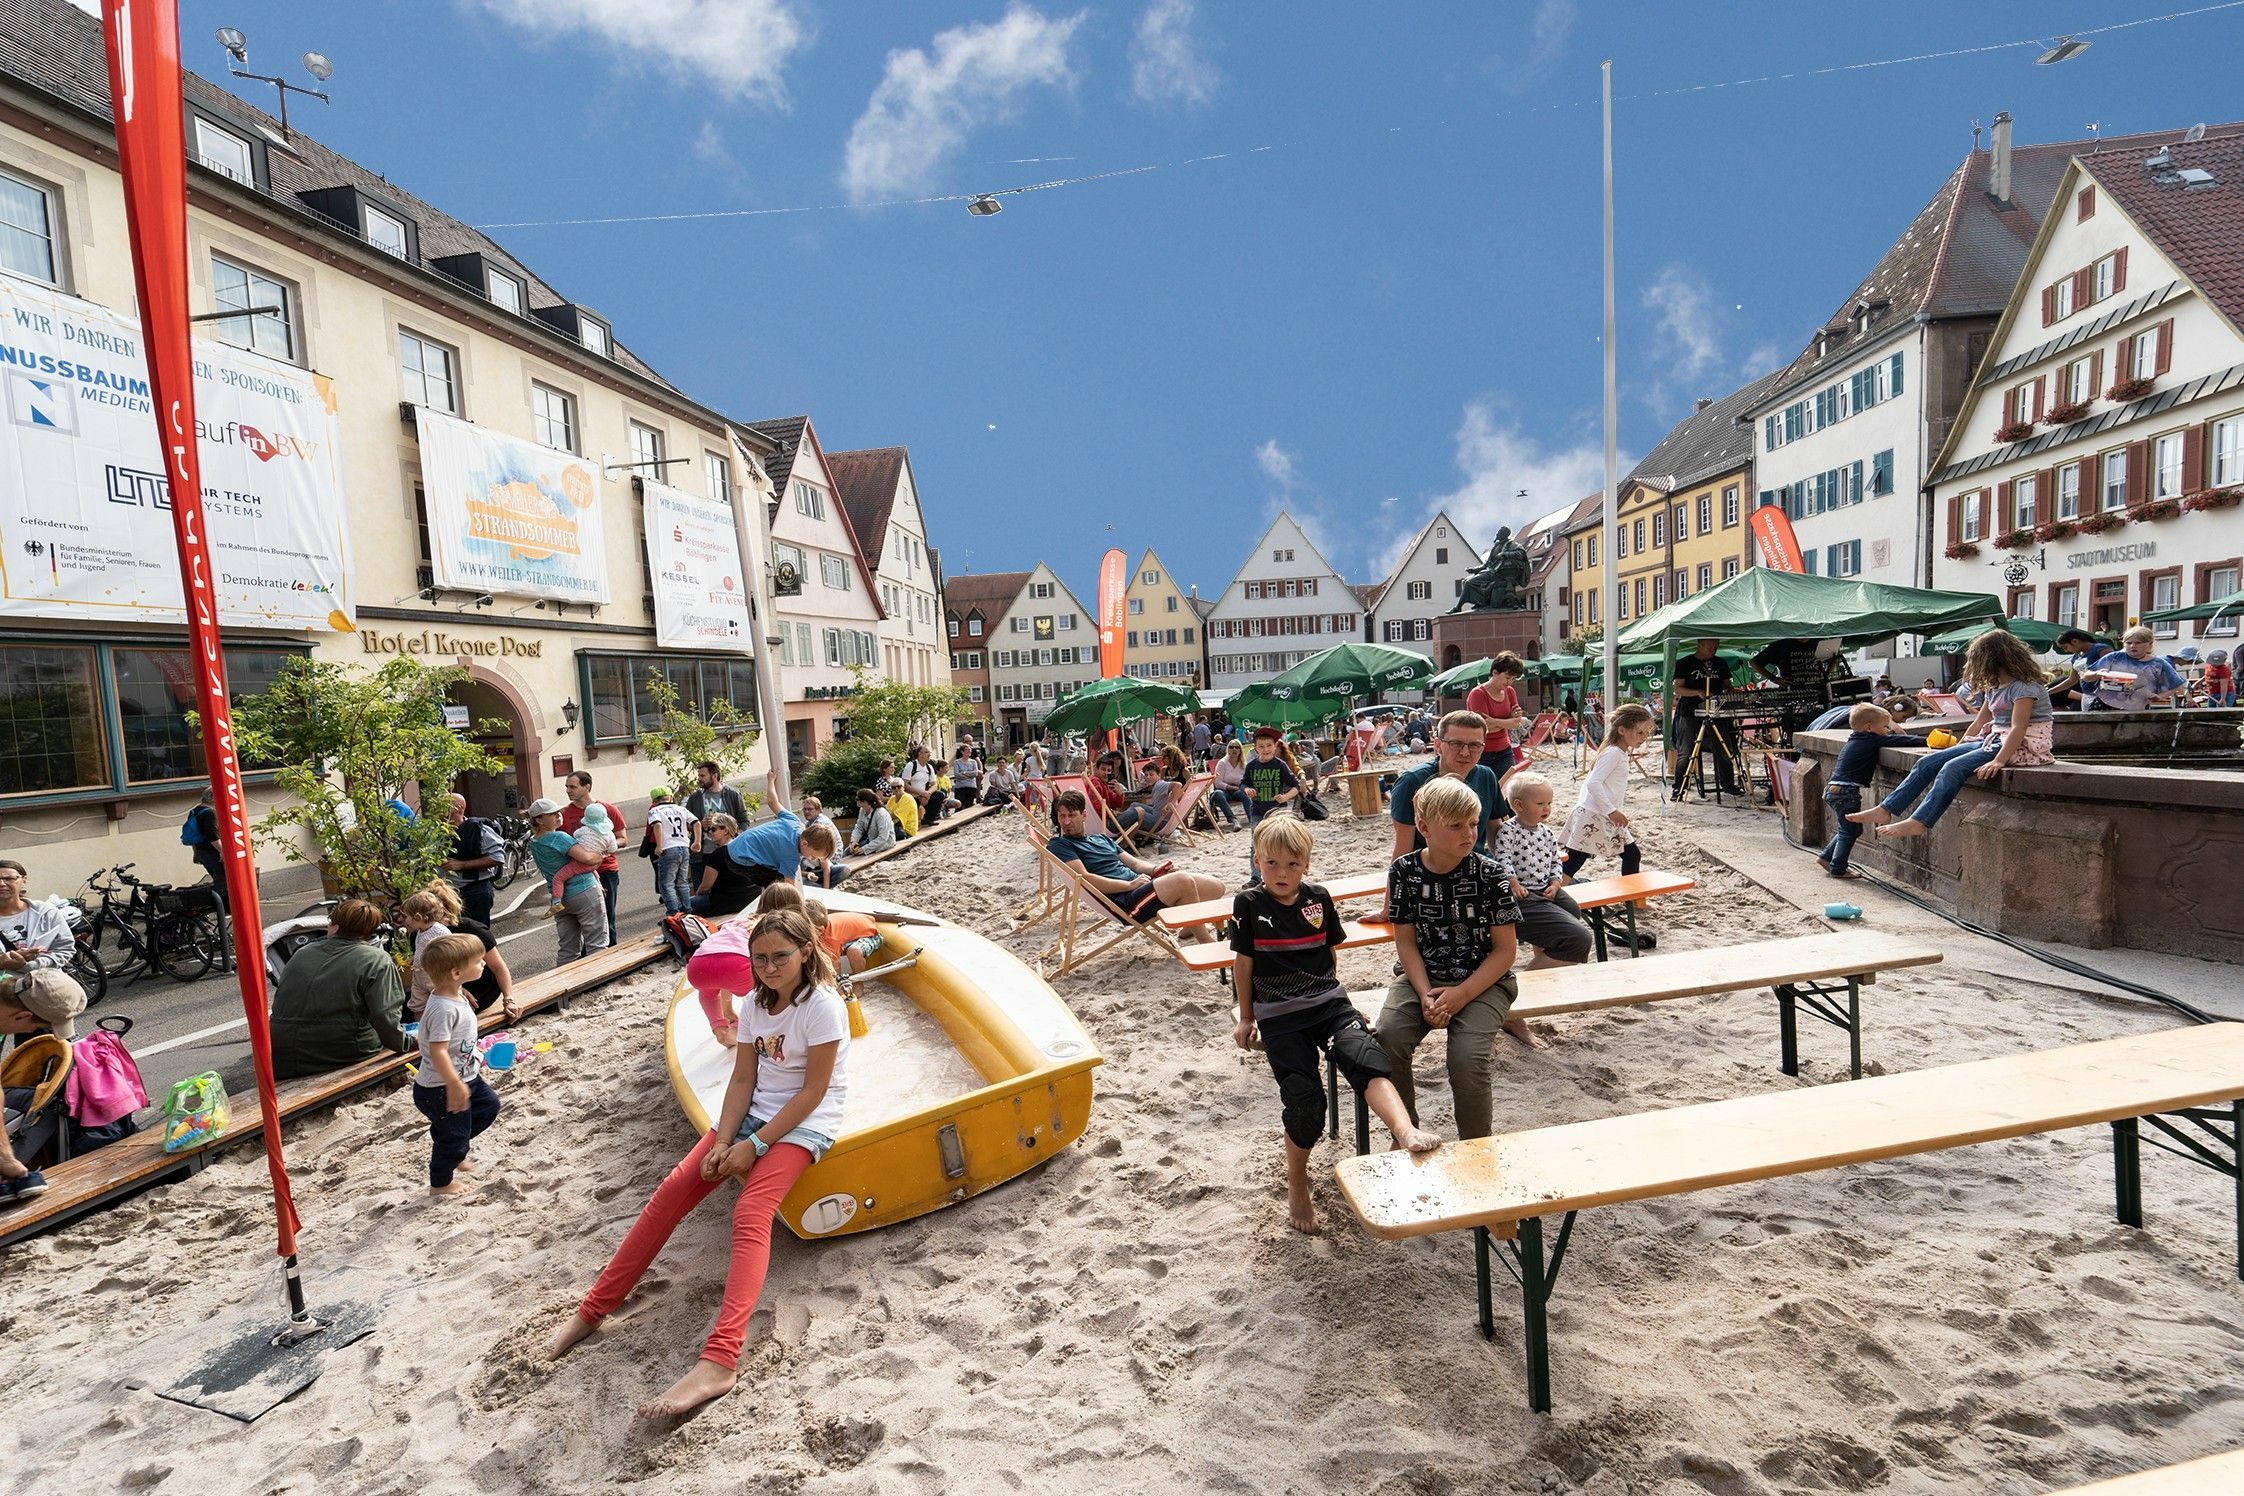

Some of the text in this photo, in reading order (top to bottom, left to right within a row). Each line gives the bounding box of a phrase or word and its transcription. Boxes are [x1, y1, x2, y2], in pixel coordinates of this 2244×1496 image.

[12, 307, 53, 336] WIR
[62, 321, 136, 358] DANKEN
[0, 343, 150, 398] NUSSBAUM
[81, 386, 151, 413] MEDIEN
[224, 490, 261, 505] TECH
[203, 501, 263, 519] YSTEMS
[68, 523, 90, 532] vom
[472, 511, 577, 549] STRANDSOMMER
[59, 543, 133, 558] Bundesministerium
[216, 541, 329, 561] im Rahmen des Bundesprogmms
[2066, 541, 2157, 569] STADTMUSEUM
[60, 552, 73, 561] für
[138, 561, 161, 569] Frauen
[61, 561, 106, 572] und Jugend
[222, 572, 289, 590] Demokratie
[661, 570, 700, 585] KESSEL
[361, 630, 543, 657] Hotel Krone Post
[1320, 684, 1350, 695] Hochdorfer
[1253, 768, 1281, 781] HAVE
[667, 816, 685, 838] 13
